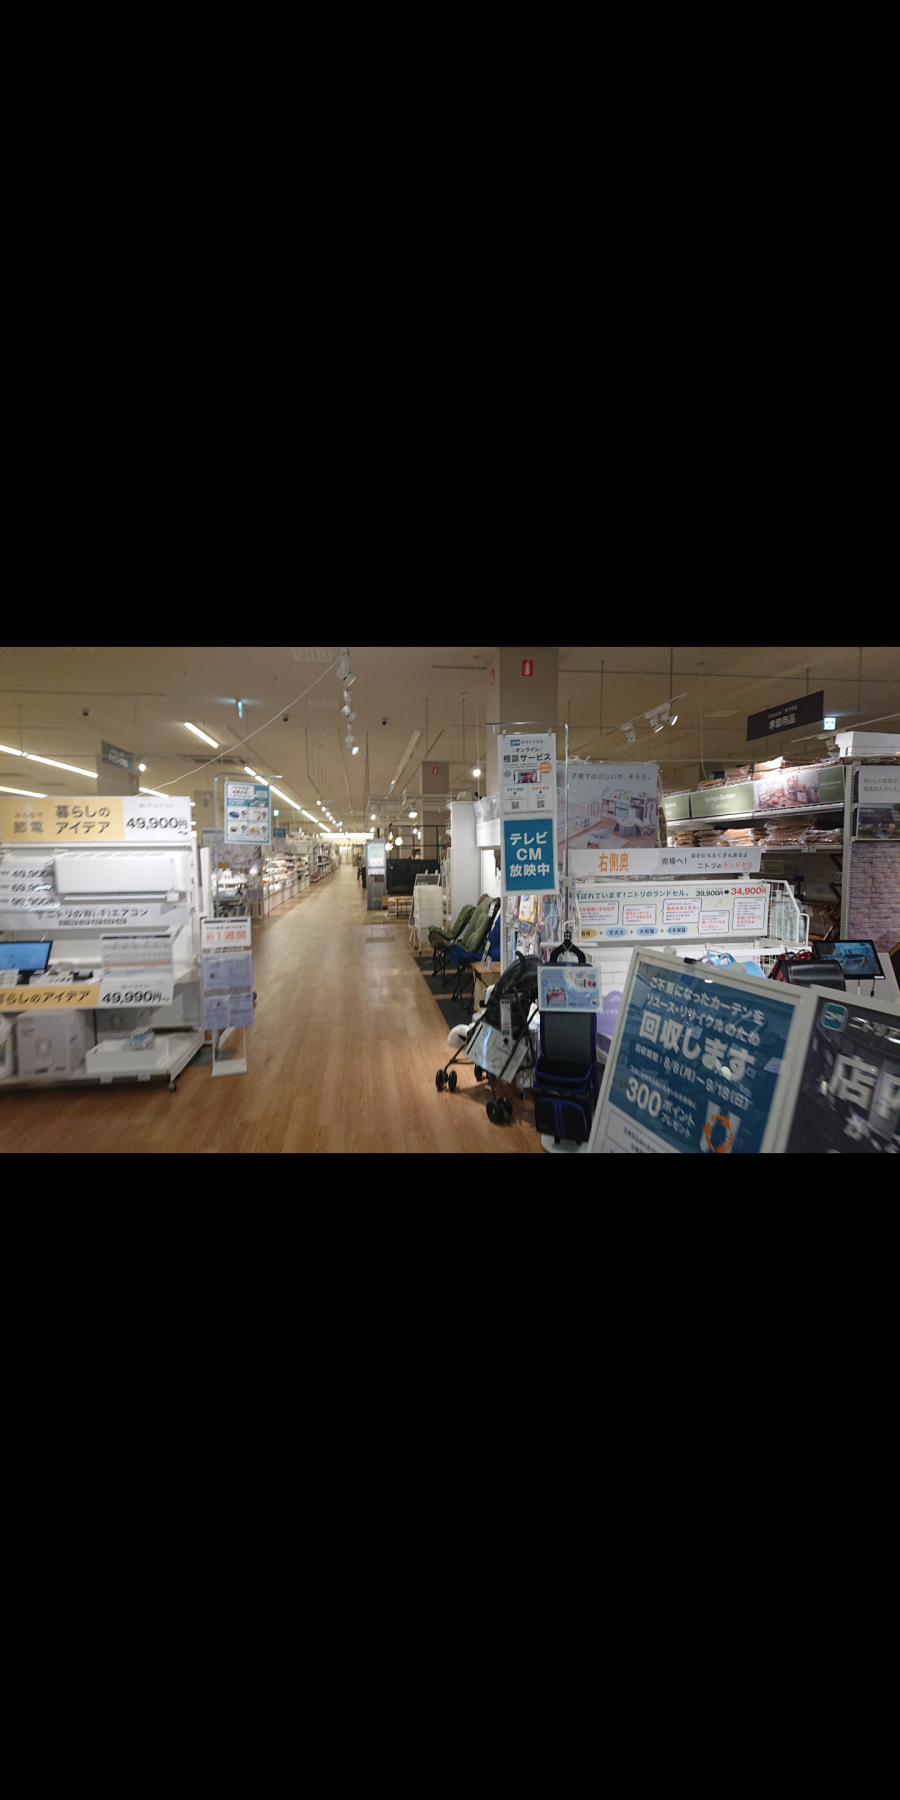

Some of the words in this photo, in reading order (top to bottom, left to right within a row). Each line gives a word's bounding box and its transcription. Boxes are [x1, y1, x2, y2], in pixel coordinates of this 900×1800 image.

[768, 713, 796, 730] 季節用品
[503, 753, 551, 763] 相談サービス
[56, 804, 111, 819] 暮らしの
[13, 820, 44, 833] 節電
[56, 821, 111, 834] アイデア
[509, 831, 548, 846] テレビ
[516, 847, 542, 861] CM
[661, 857, 687, 866] 売場へ!
[509, 862, 550, 877] 放映中
[598, 852, 629, 872] 右側奥
[697, 861, 753, 869] ニトリのランドセル
[730, 886, 767, 896] 34,900円
[650, 976, 765, 1026] ご不要になったカーテンを
[639, 1010, 756, 1083] 回収します
[626, 1077, 662, 1117] 300
[662, 1099, 696, 1127] ポイント
